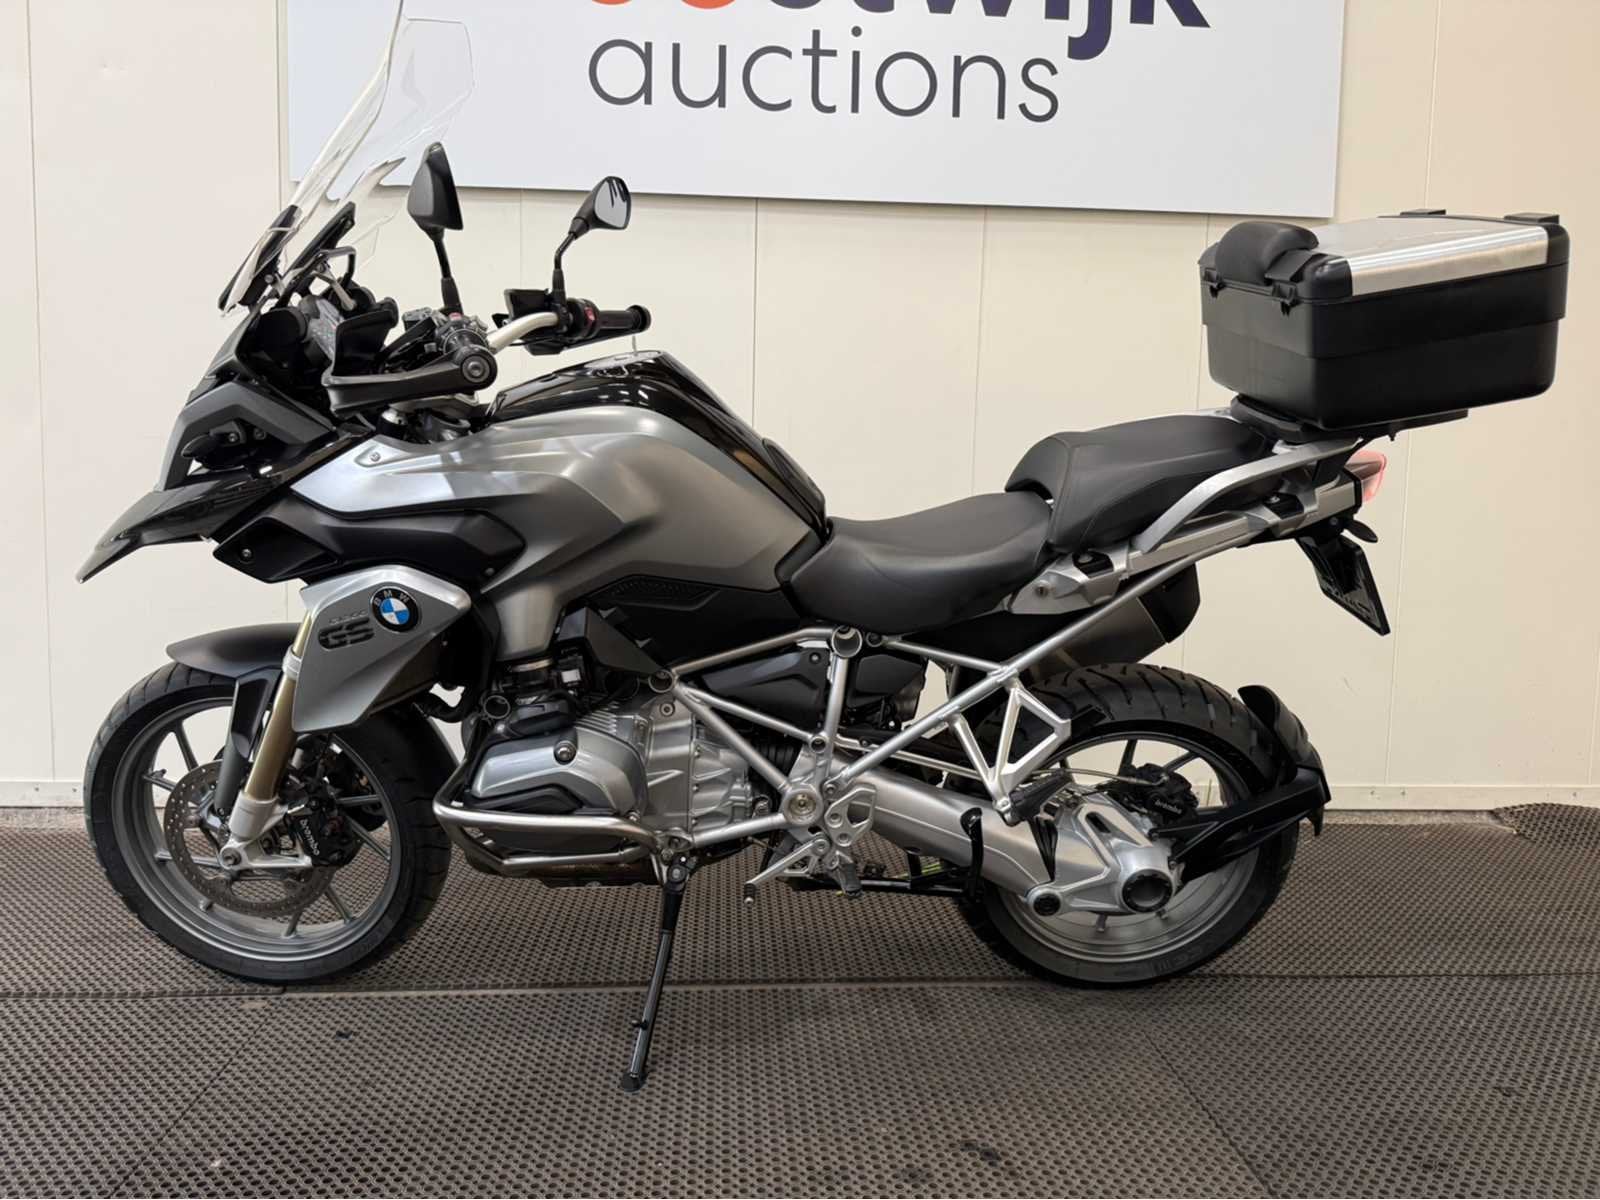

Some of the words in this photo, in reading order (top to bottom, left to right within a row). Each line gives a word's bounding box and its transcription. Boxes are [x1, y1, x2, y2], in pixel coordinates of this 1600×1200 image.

[588, 25, 1059, 123] auctions
[373, 590, 410, 606] BMW
[318, 617, 375, 650] GS
[300, 818, 320, 856] brembo
